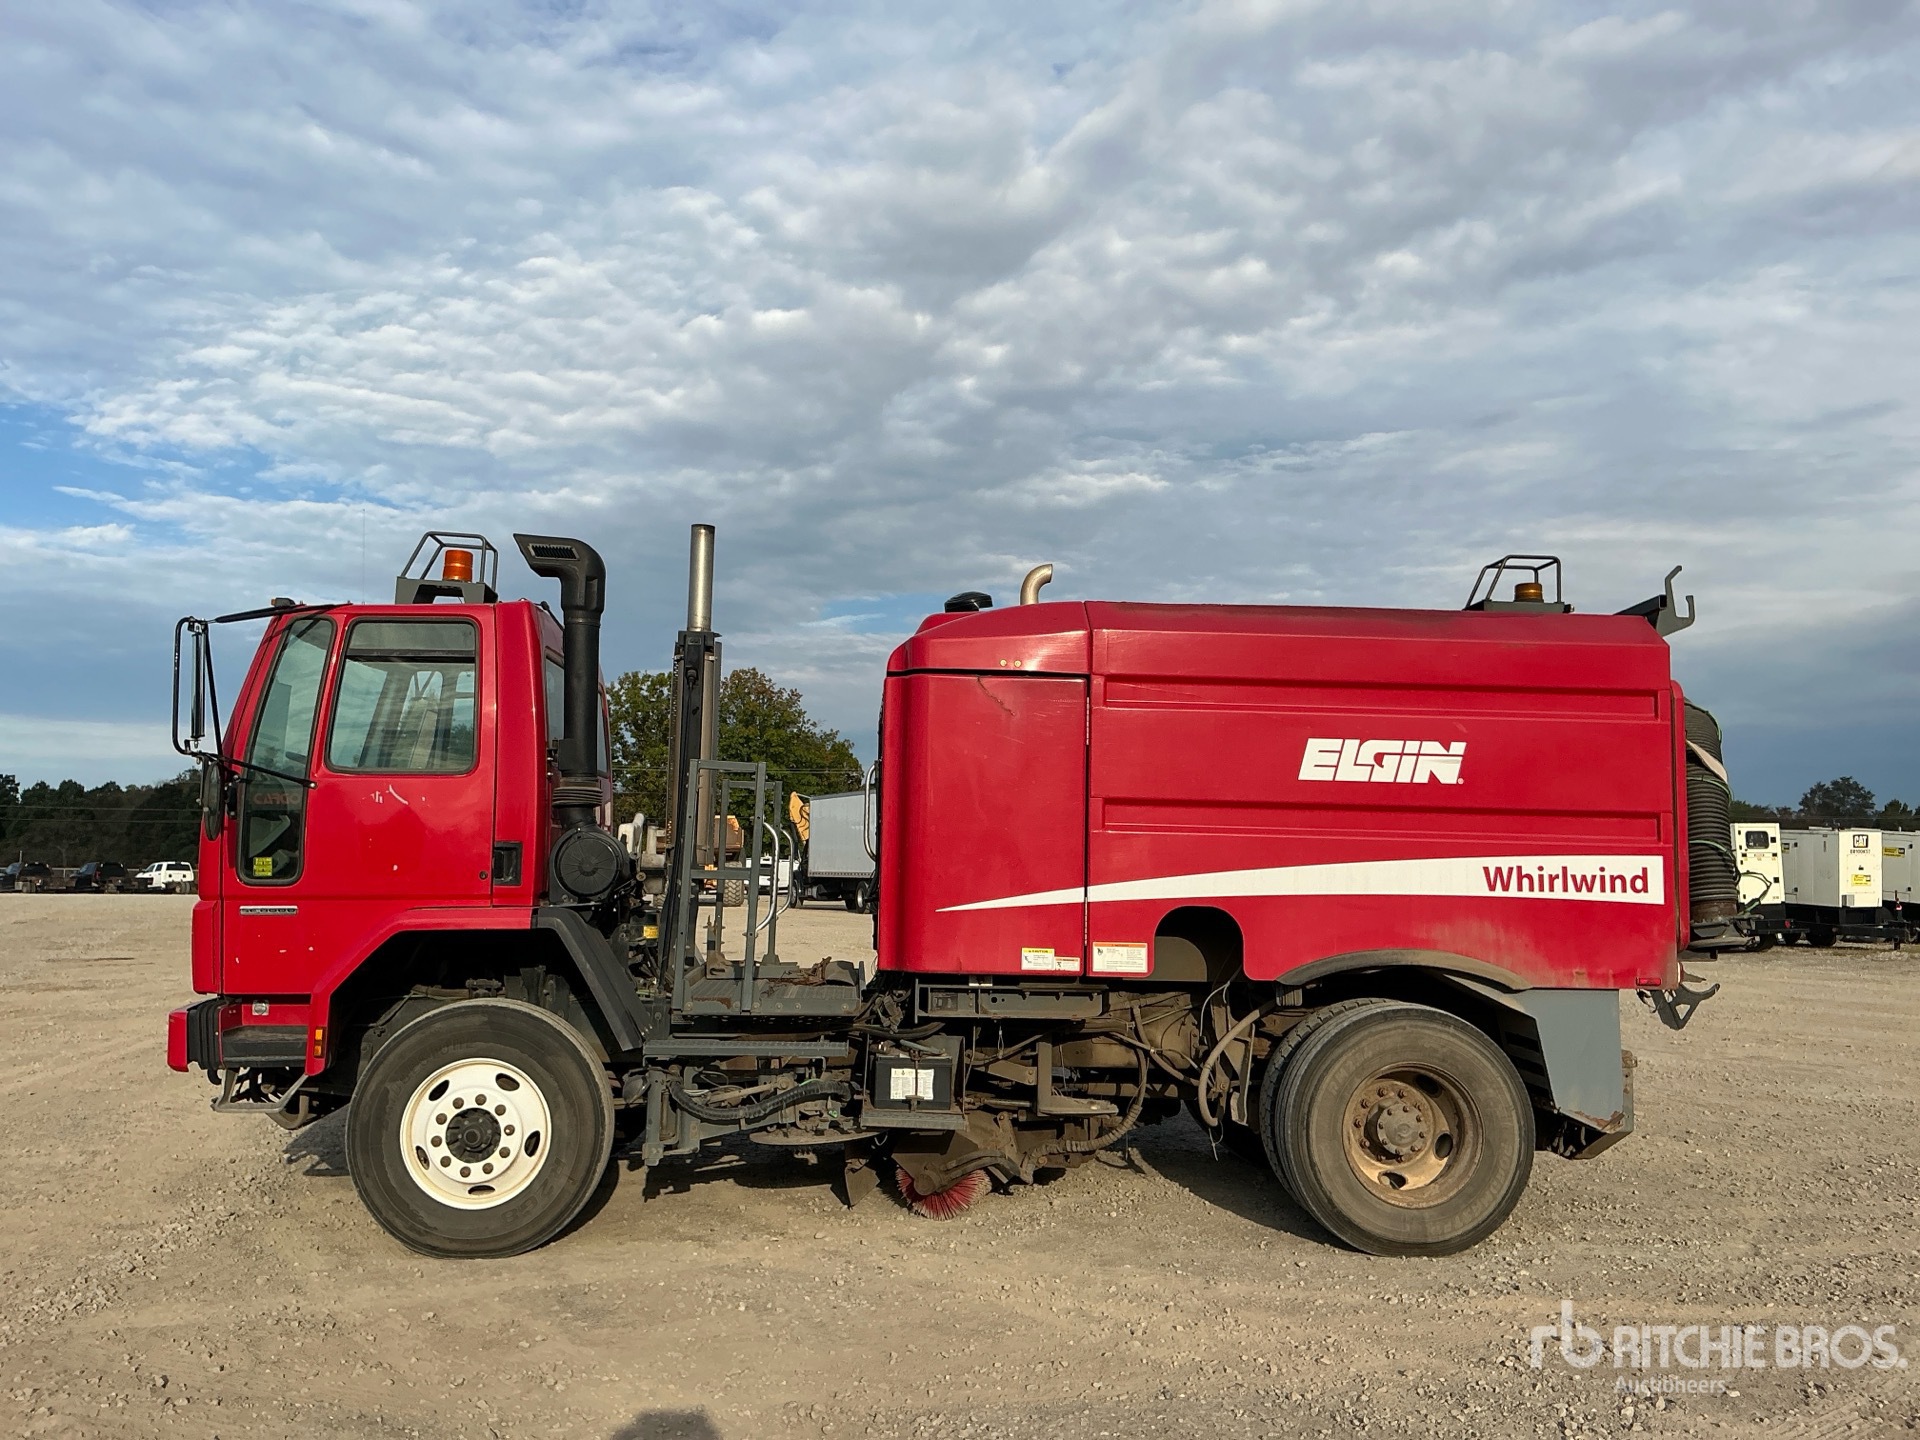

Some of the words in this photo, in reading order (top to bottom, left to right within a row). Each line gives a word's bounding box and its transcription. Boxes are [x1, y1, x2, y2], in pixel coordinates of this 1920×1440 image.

[1298, 738, 1467, 784] ELGIN
[1854, 835, 1868, 847] CAT
[1483, 865, 1649, 894] Whirlwind
